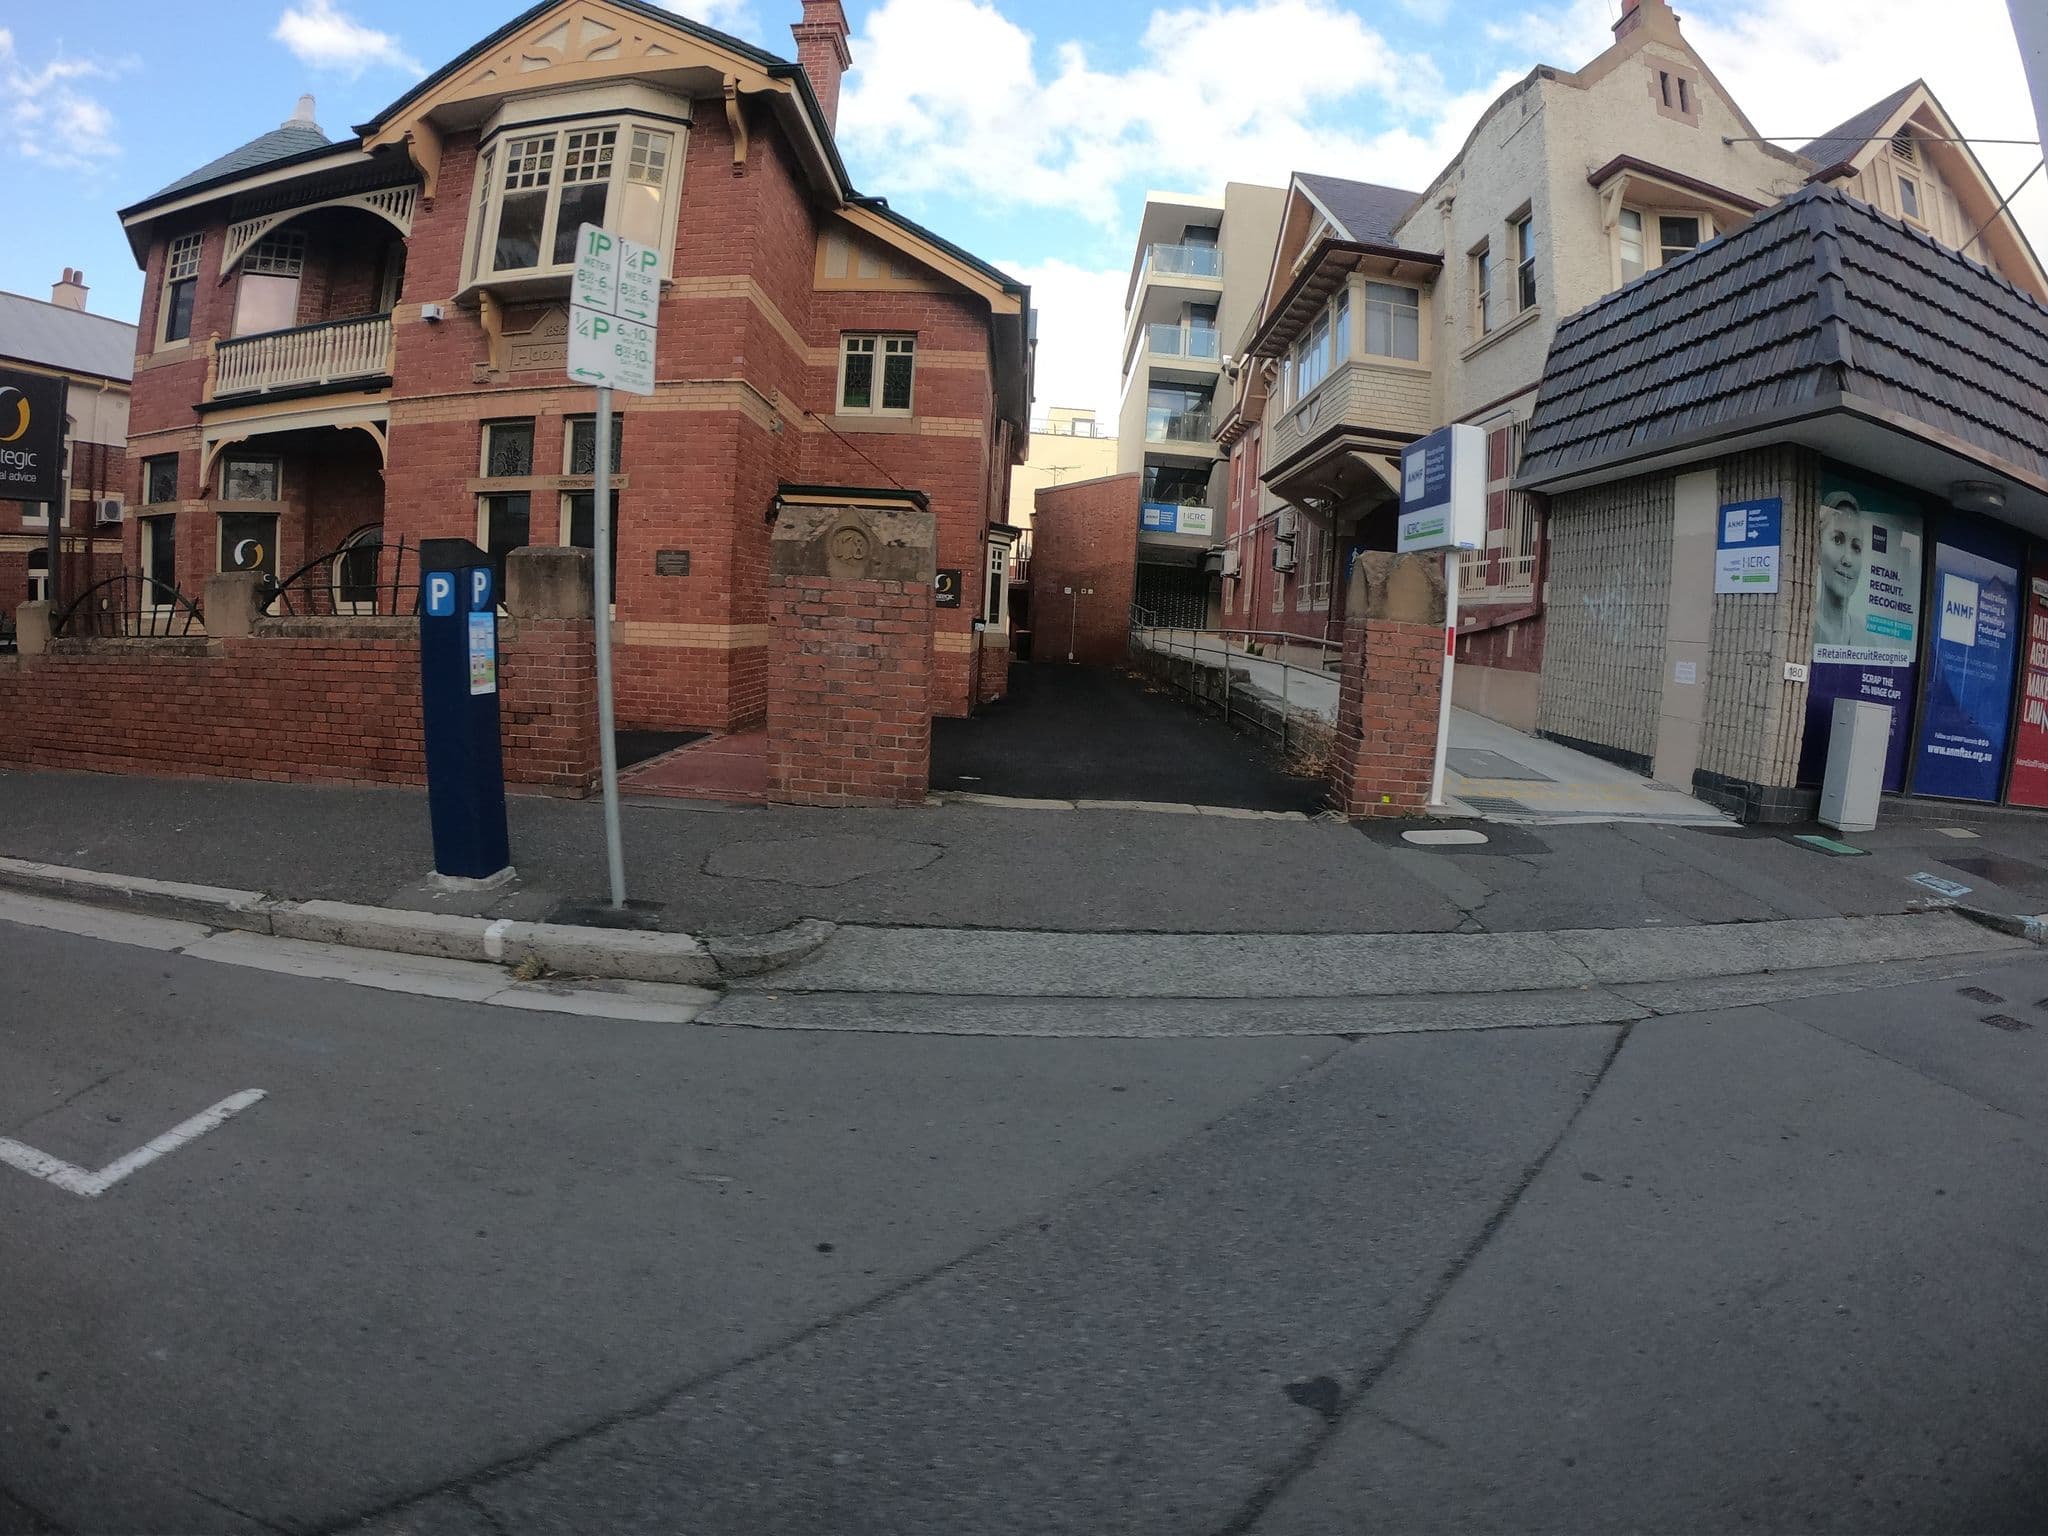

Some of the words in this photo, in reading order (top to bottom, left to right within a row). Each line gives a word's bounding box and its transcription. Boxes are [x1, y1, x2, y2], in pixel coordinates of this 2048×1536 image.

[589, 231, 613, 256] 1P
[584, 256, 611, 271] METER
[625, 270, 654, 285] METER
[9, 472, 37, 482] advice
[1183, 512, 1207, 521] HERC
[1727, 520, 1745, 529] ANMF
[1743, 556, 1770, 568] HERC
[1870, 565, 1901, 582] RETAIN.
[431, 578, 450, 610] P
[474, 571, 487, 603] P
[1869, 580, 1904, 597] RECRUIT.
[1868, 594, 1914, 615] RECOGNISE.
[1946, 600, 1974, 619] ANMF
[1978, 623, 2007, 640] Federation
[1817, 648, 1908, 665] #RetainRecruitRecognise
[1789, 667, 1803, 678] 180
[1862, 673, 1881, 684] SCRAP
[1882, 677, 1894, 688] THE
[1870, 686, 1888, 697] WAGE
[1887, 690, 1901, 700] CAP!
